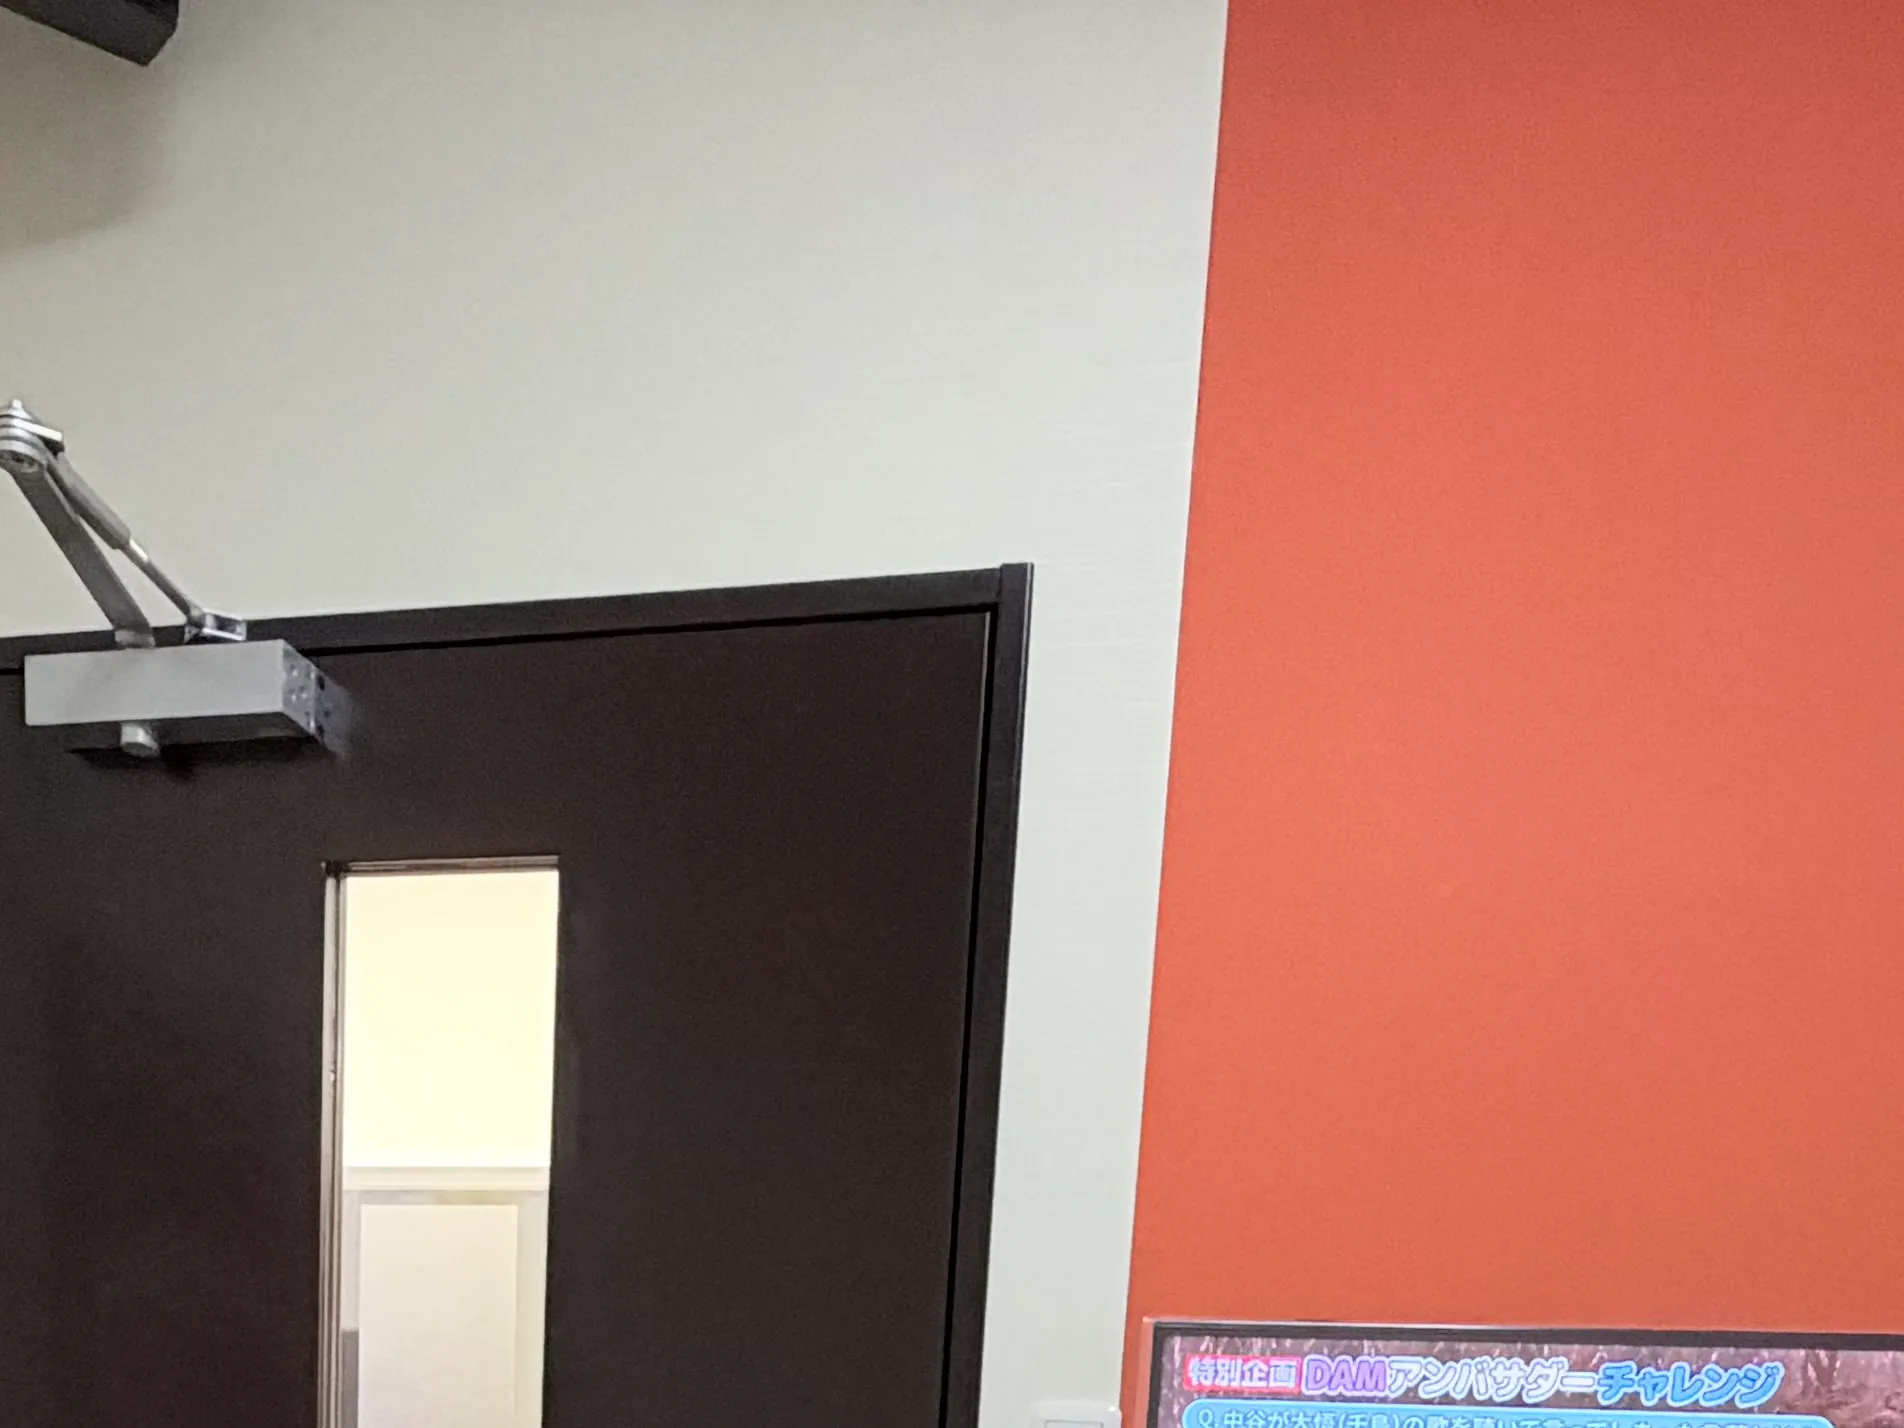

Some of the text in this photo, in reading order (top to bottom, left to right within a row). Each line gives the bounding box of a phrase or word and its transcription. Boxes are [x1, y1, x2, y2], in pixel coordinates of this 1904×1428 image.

[1187, 1354, 1786, 1408] 特別企画 DAMアンバサダーチャレンジ
